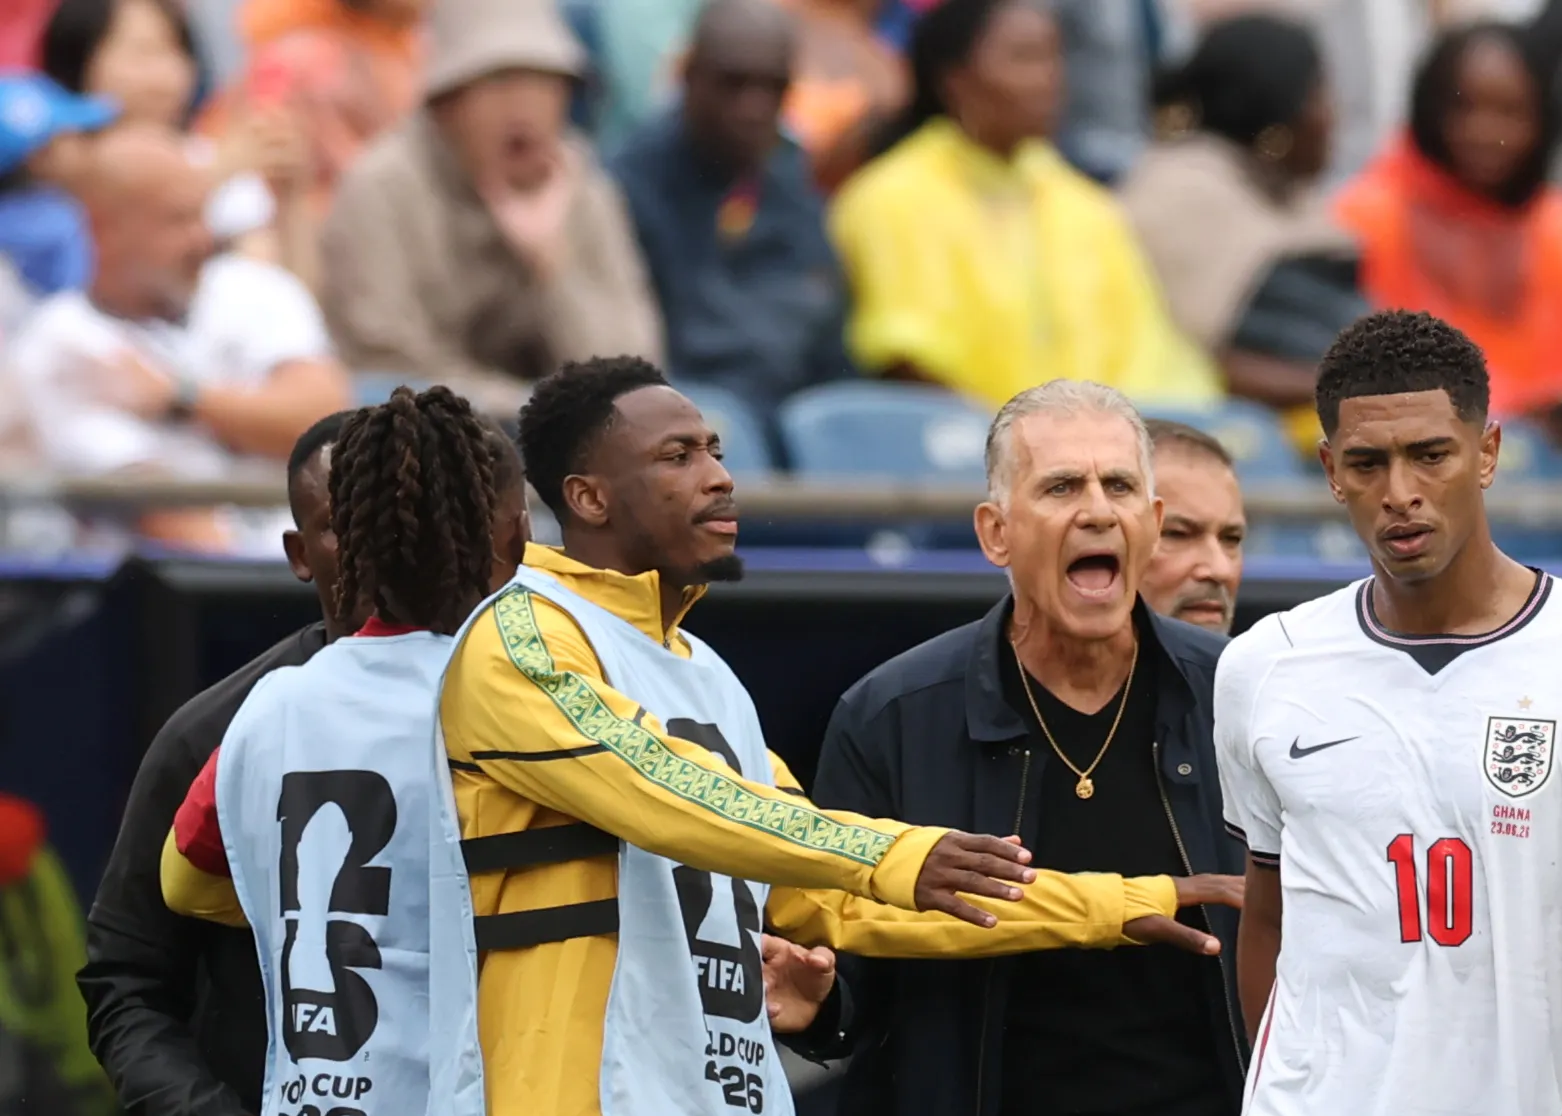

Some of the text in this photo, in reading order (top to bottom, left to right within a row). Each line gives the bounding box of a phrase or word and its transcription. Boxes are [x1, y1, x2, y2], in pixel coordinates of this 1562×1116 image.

[1493, 804, 1530, 821] GHANA
[1387, 834, 1473, 947] 10
[737, 1037, 765, 1067] CUP
[311, 1073, 373, 1100] CUP
